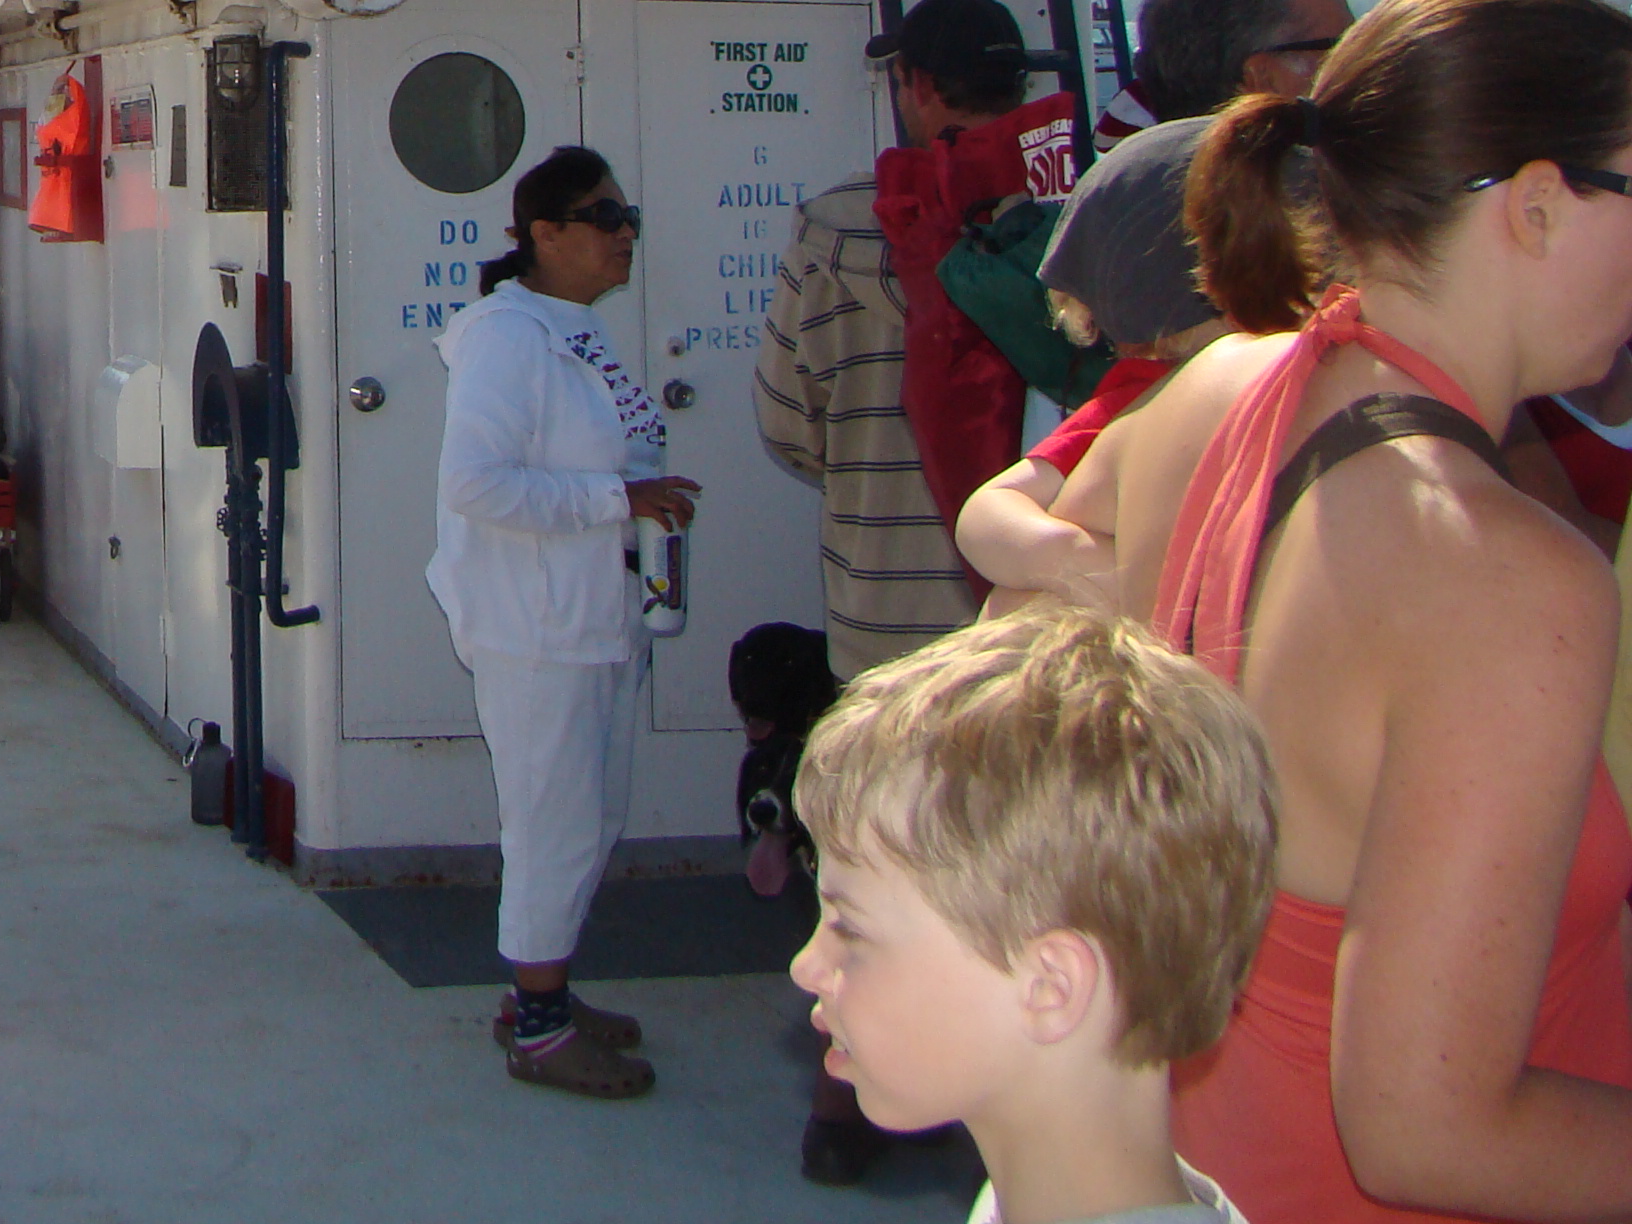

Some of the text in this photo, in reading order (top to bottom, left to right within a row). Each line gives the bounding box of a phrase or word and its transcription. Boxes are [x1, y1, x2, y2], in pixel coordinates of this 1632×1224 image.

[714, 41, 806, 62] FIRST AID
[721, 91, 799, 113] STATION
[1028, 144, 1075, 196] DIC
[718, 182, 806, 208] ADULT
[440, 219, 478, 245] DO
[725, 288, 775, 314] LIF
[402, 301, 466, 328] ENT
[685, 326, 761, 351] PRES
